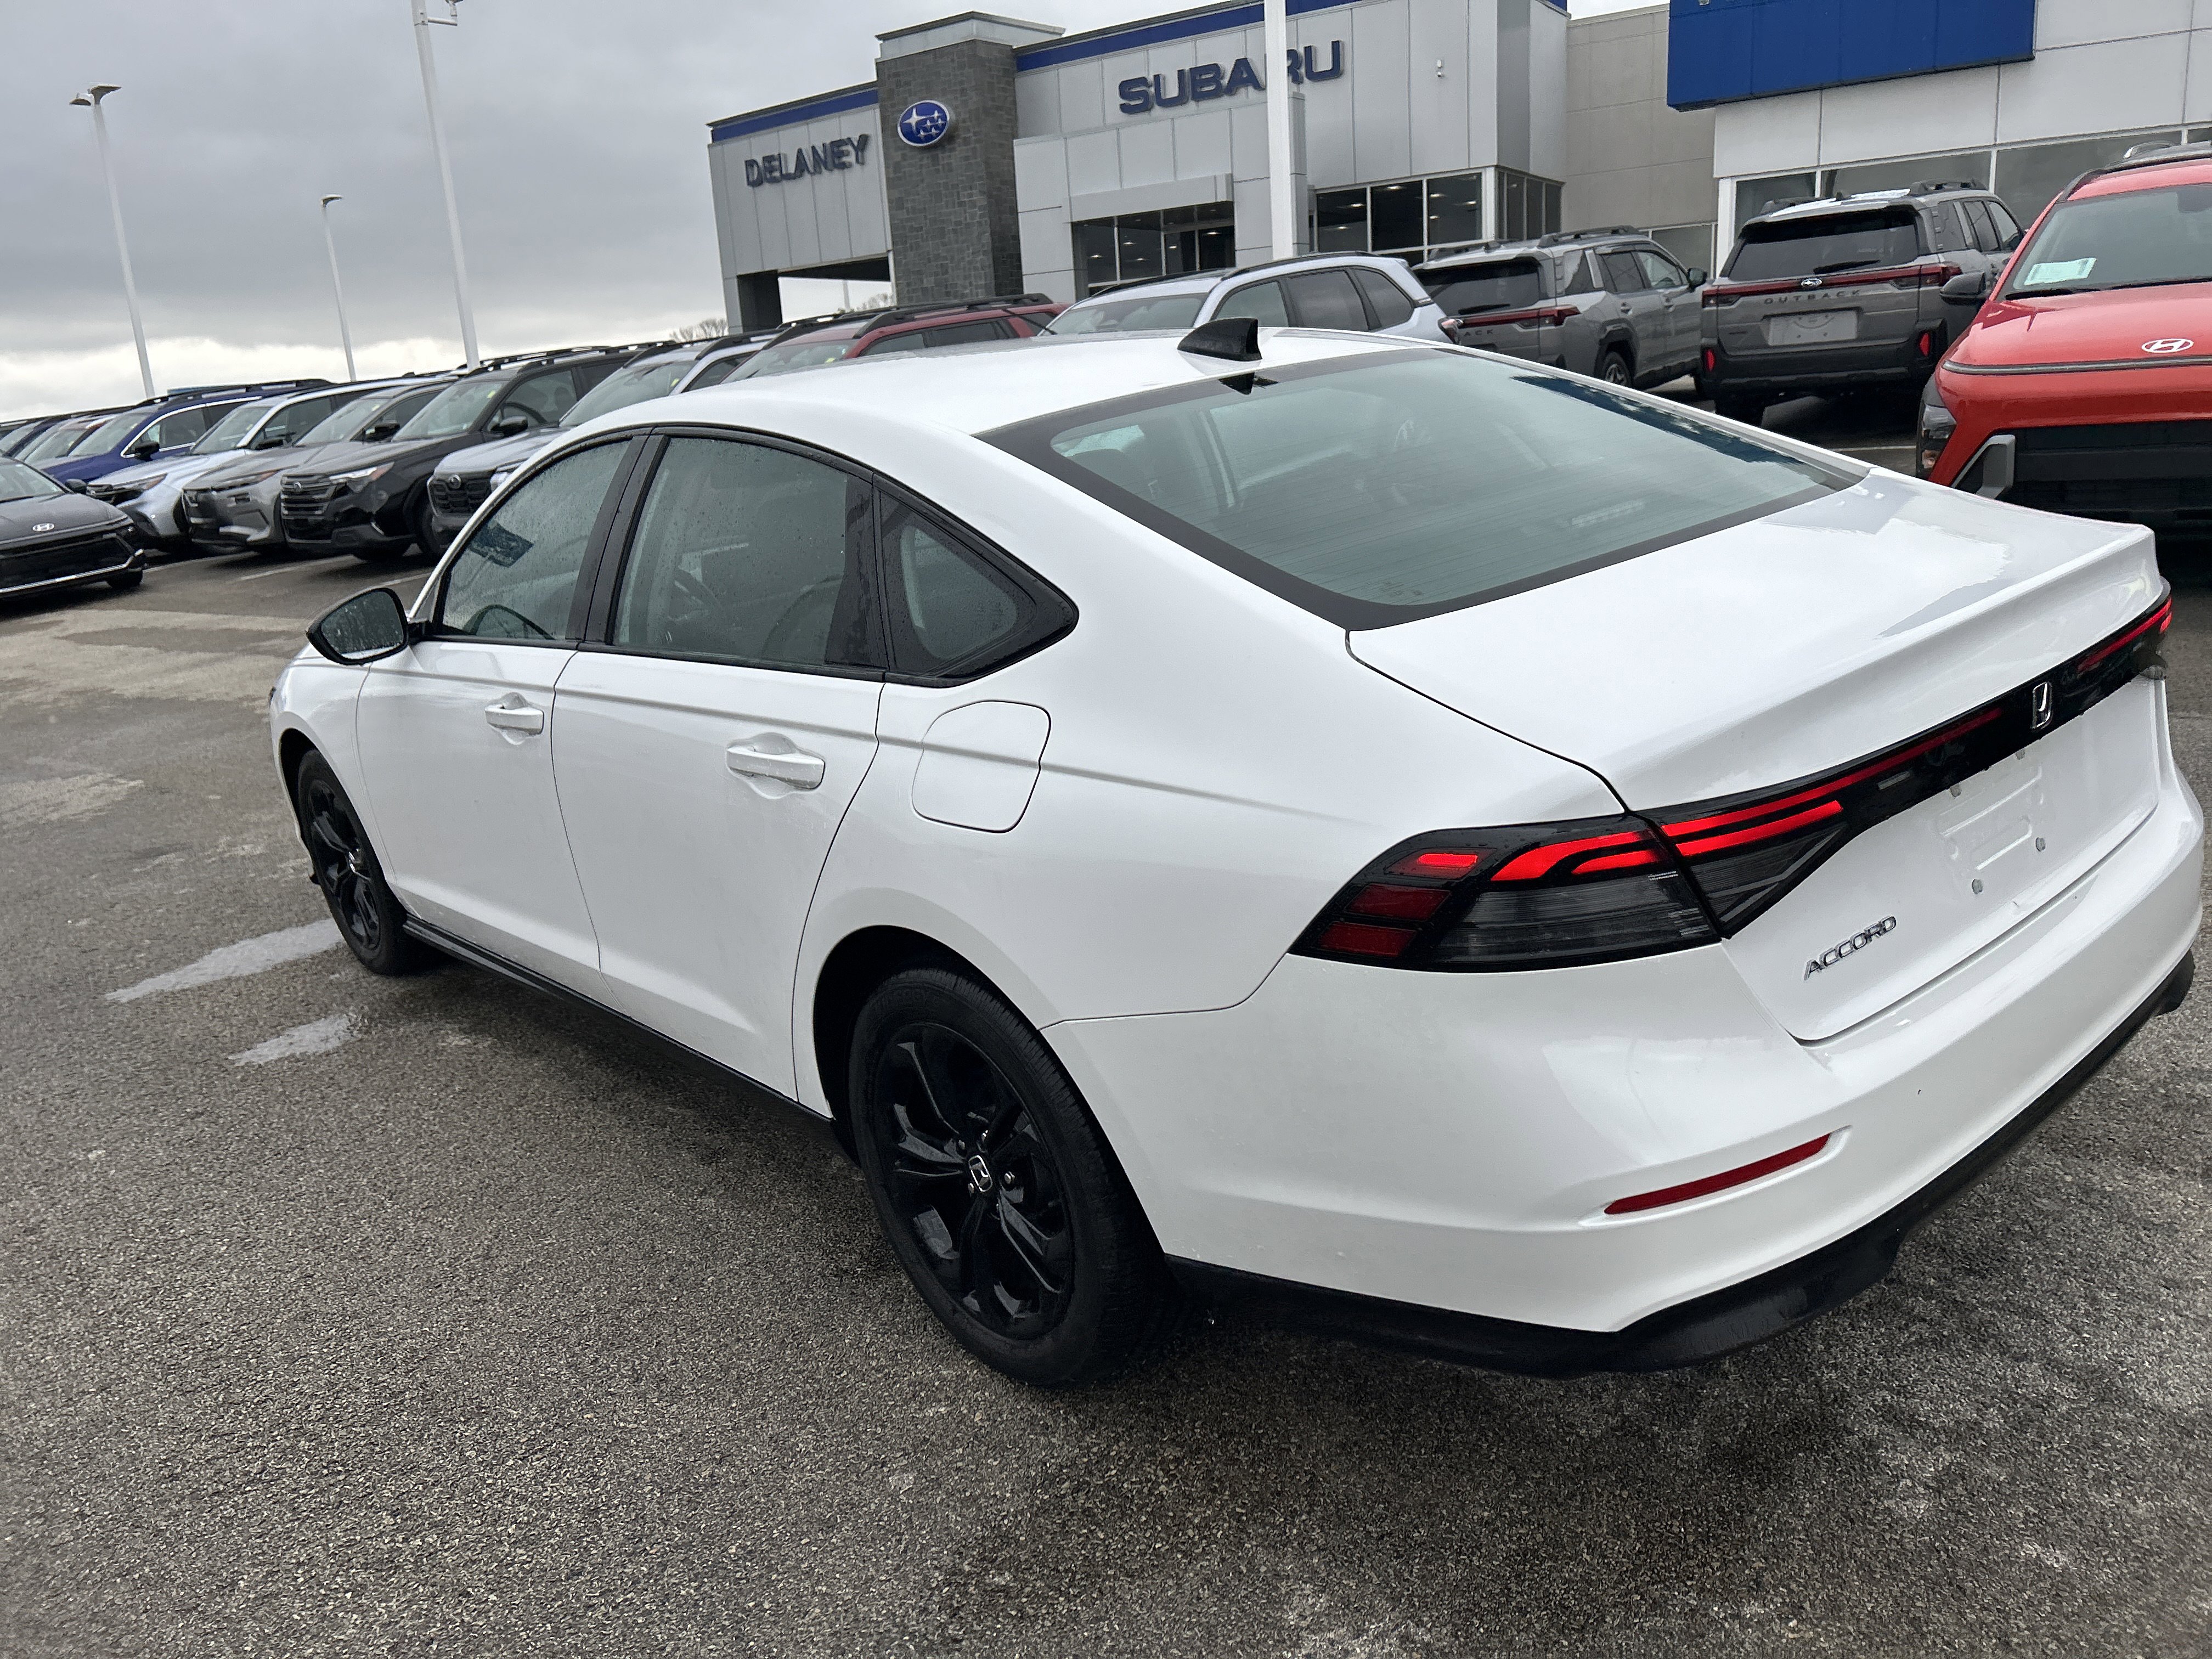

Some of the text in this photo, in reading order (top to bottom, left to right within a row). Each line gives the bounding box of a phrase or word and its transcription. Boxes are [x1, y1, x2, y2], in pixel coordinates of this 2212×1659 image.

[744, 134, 870, 187] DELANEY
[1764, 289, 1861, 304] OUTBACK
[1803, 915, 1897, 981] ACCORD
